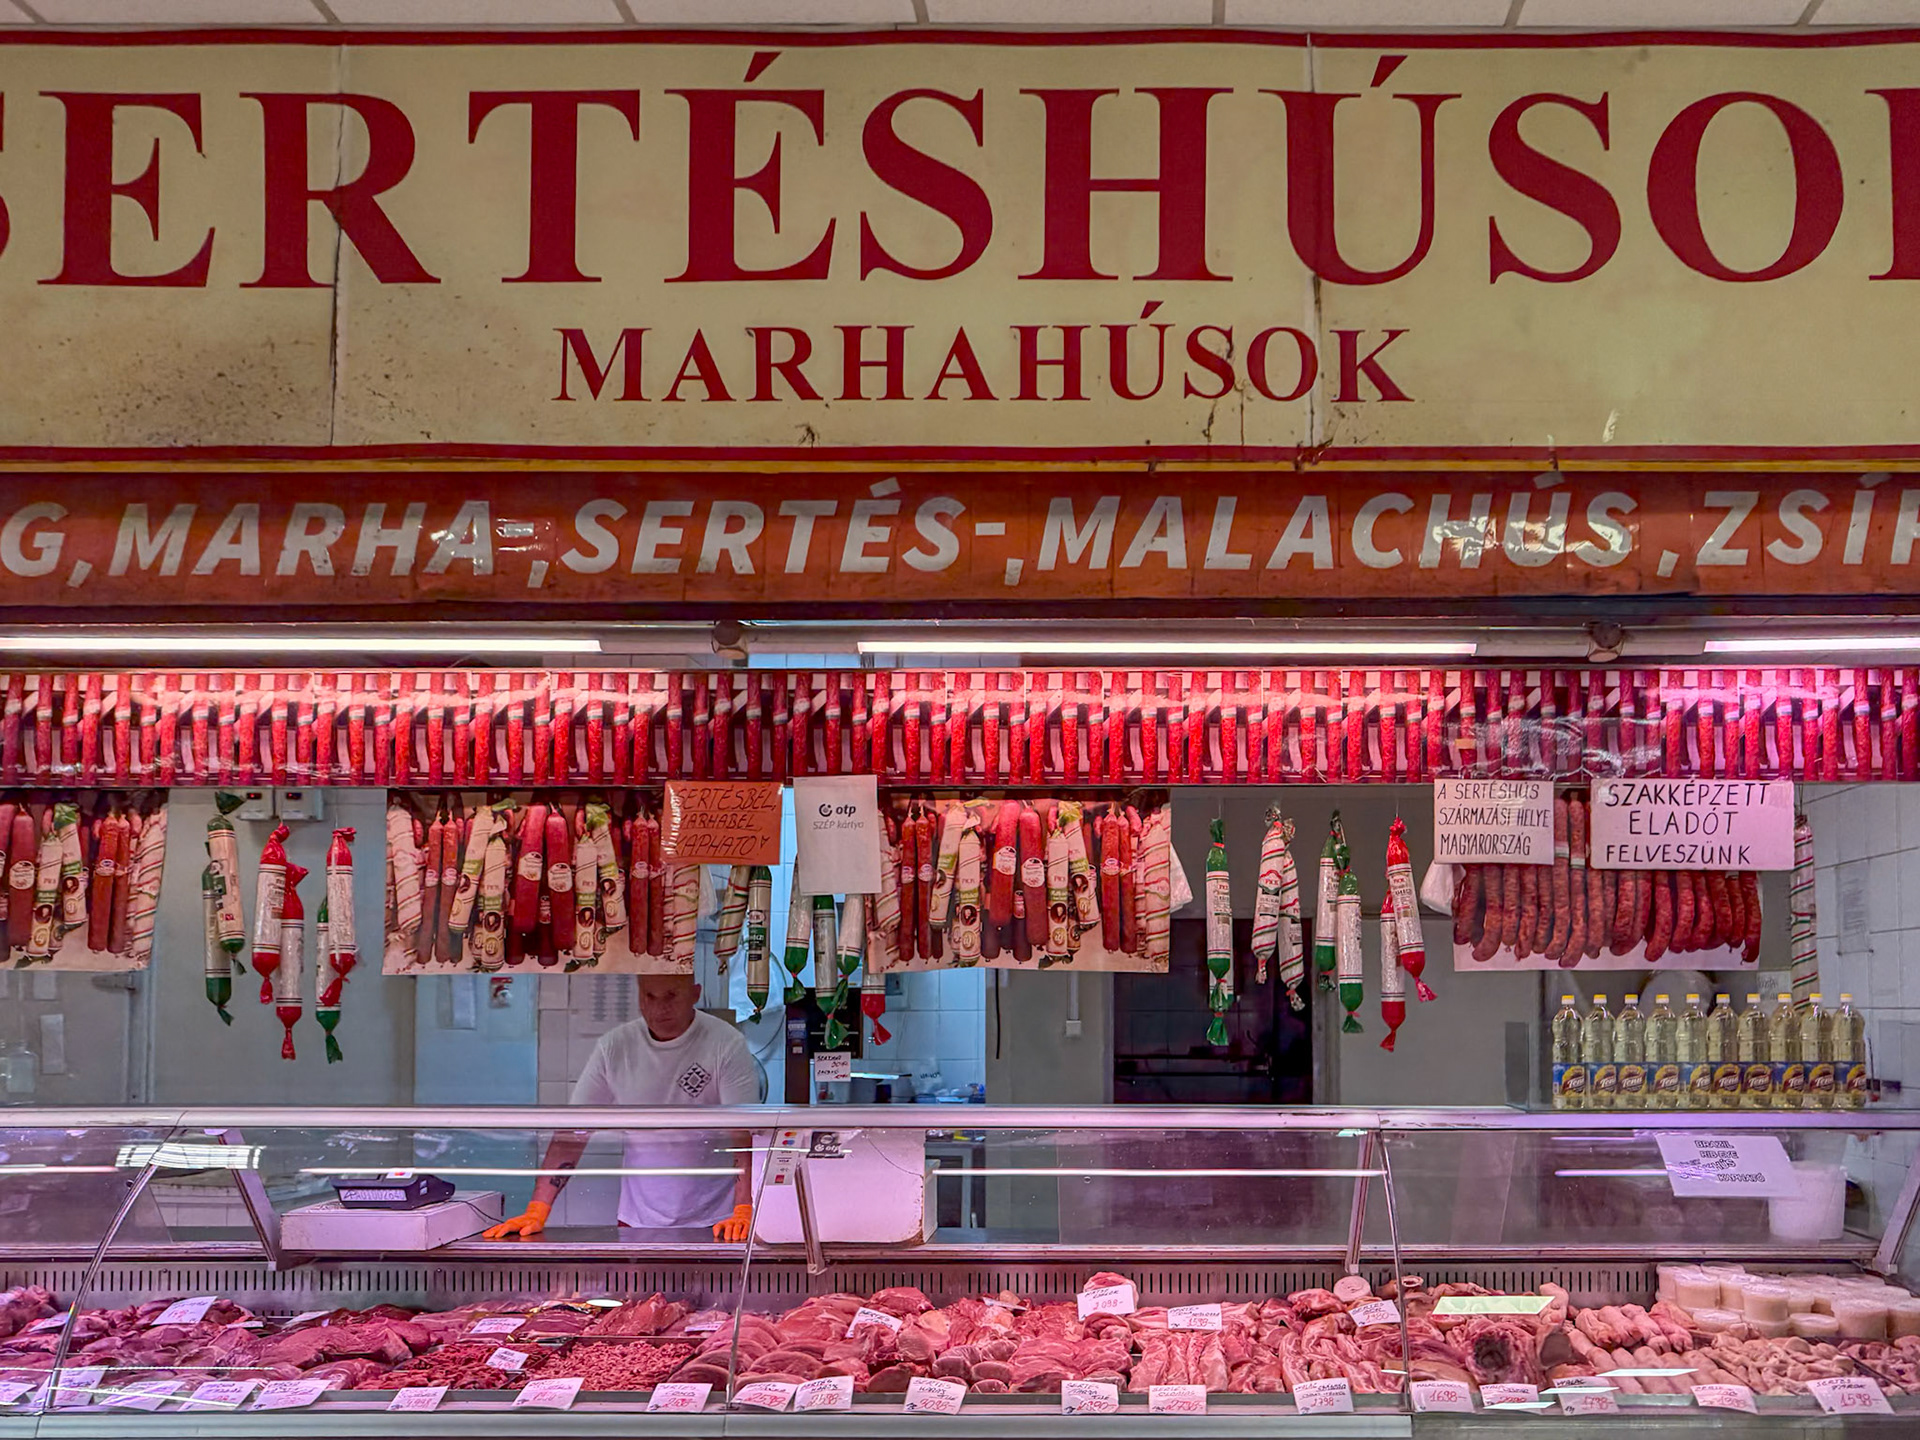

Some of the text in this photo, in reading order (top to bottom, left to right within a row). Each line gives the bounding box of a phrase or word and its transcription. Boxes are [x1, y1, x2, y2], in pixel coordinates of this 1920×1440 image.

[0, 52, 1920, 288] ERTÉSHÚSO
[553, 301, 1415, 403] MARHAHÚSOK
[1437, 781, 1540, 800] A SERTÉSHÚS
[1604, 779, 1771, 807] SZAKKÉPZETT
[835, 804, 857, 818] otp
[1438, 803, 1551, 828] SZÁRMAZÁSI HELYE
[1629, 807, 1739, 836] ELADÓT
[813, 819, 836, 830] SZÉP
[1440, 832, 1531, 856] MAGYARORSZÁG
[1606, 840, 1751, 865] FELVESZÜNK
